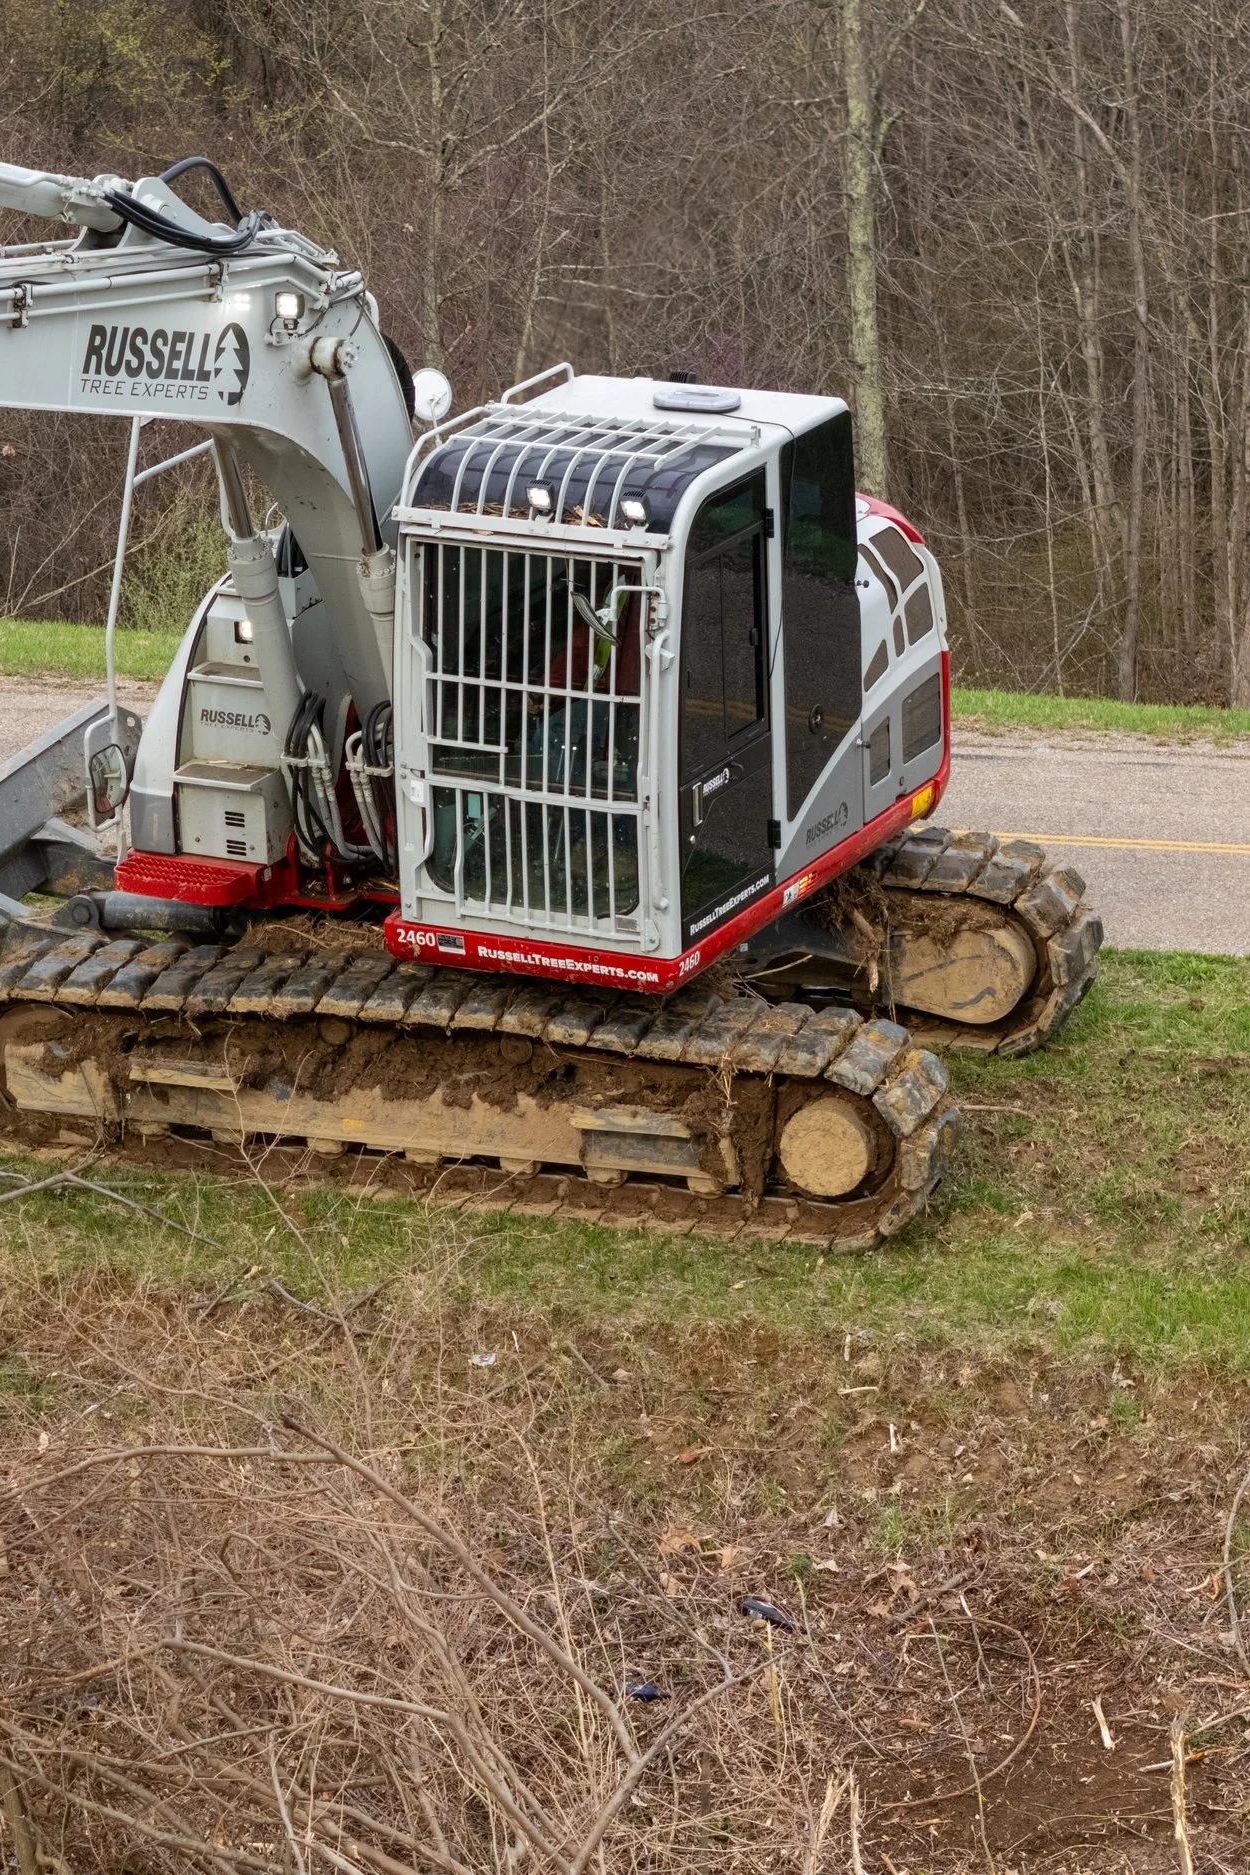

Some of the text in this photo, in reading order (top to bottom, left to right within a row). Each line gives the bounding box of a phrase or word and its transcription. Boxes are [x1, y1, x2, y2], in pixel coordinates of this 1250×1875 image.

[82, 324, 212, 382] RUSSELL
[80, 378, 209, 400] TREE EXPERTS
[200, 708, 255, 728] RUSSELL
[806, 810, 839, 846] RUSSELL
[396, 928, 436, 947] 2460
[678, 955, 701, 977] 2460
